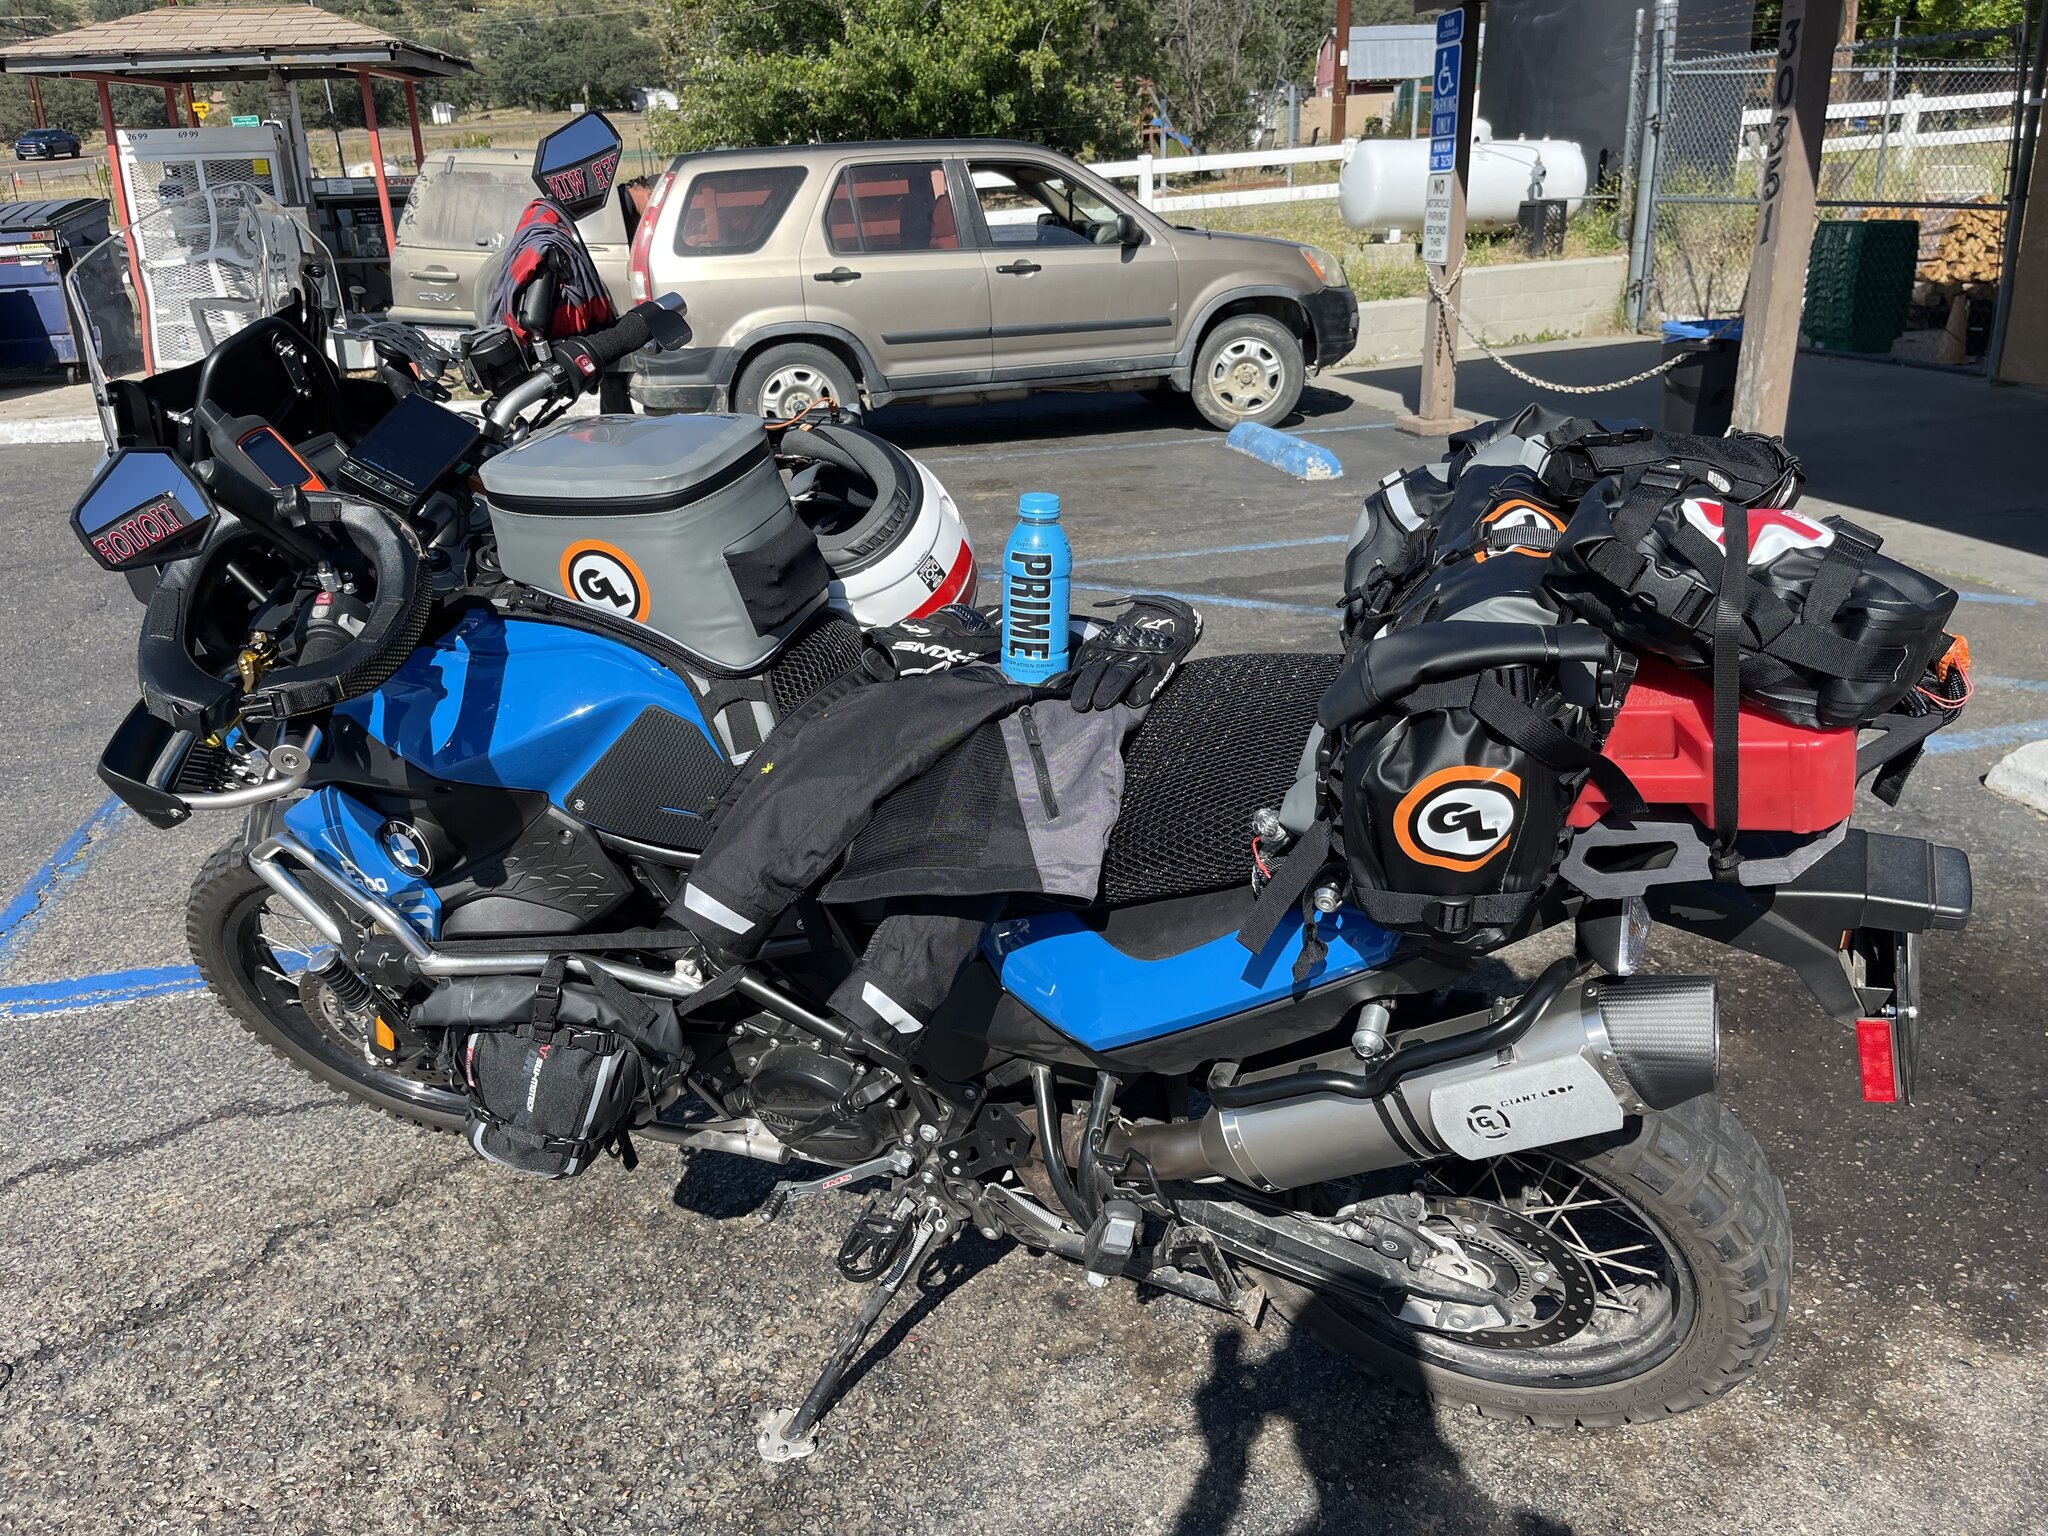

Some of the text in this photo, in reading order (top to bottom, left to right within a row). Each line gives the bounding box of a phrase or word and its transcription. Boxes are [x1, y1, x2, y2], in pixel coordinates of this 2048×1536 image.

[1759, 18, 1801, 245] 30351
[1433, 179, 1445, 194] NO
[1426, 225, 1447, 236] BEYOND
[1430, 237, 1442, 247] THIS
[922, 560, 941, 585] DOT
[579, 569, 632, 608] GL
[1009, 551, 1053, 661] PRIME
[1427, 802, 1499, 842] GL
[383, 823, 416, 844] BMW
[526, 1056, 544, 1113] SW-MOTECH
[1500, 1085, 1574, 1107] GIANT LOOP
[758, 1109, 796, 1127] BMW
[1476, 1116, 1500, 1130] GL
[822, 1173, 853, 1189] IMS
